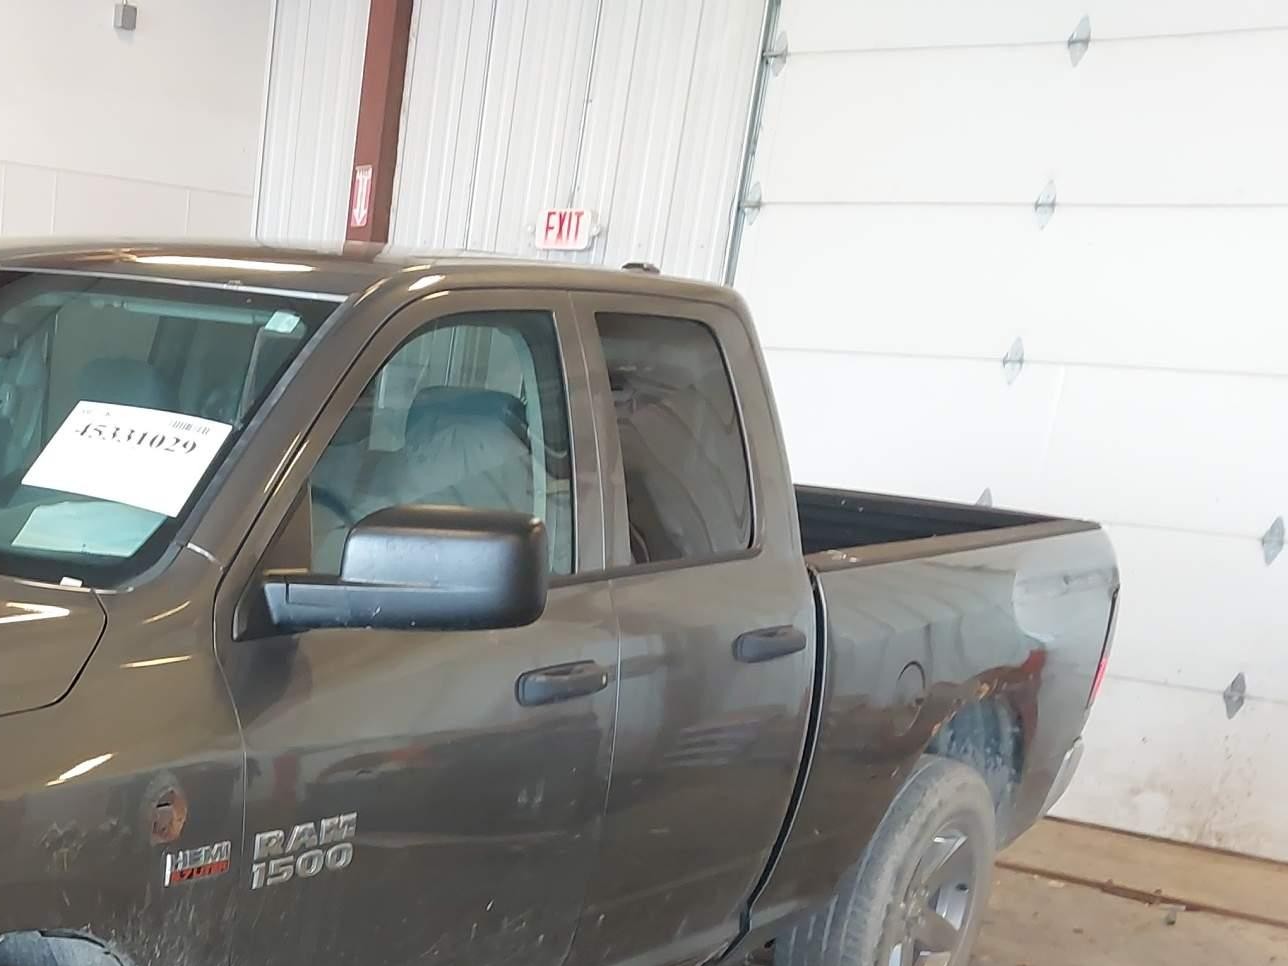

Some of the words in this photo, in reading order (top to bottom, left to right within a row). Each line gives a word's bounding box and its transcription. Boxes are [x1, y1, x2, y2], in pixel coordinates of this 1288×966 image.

[544, 211, 585, 243] EXIT
[74, 422, 197, 455] 45331029
[253, 811, 358, 861] RAM
[164, 840, 231, 887] HEMI
[251, 842, 354, 890] 1500
